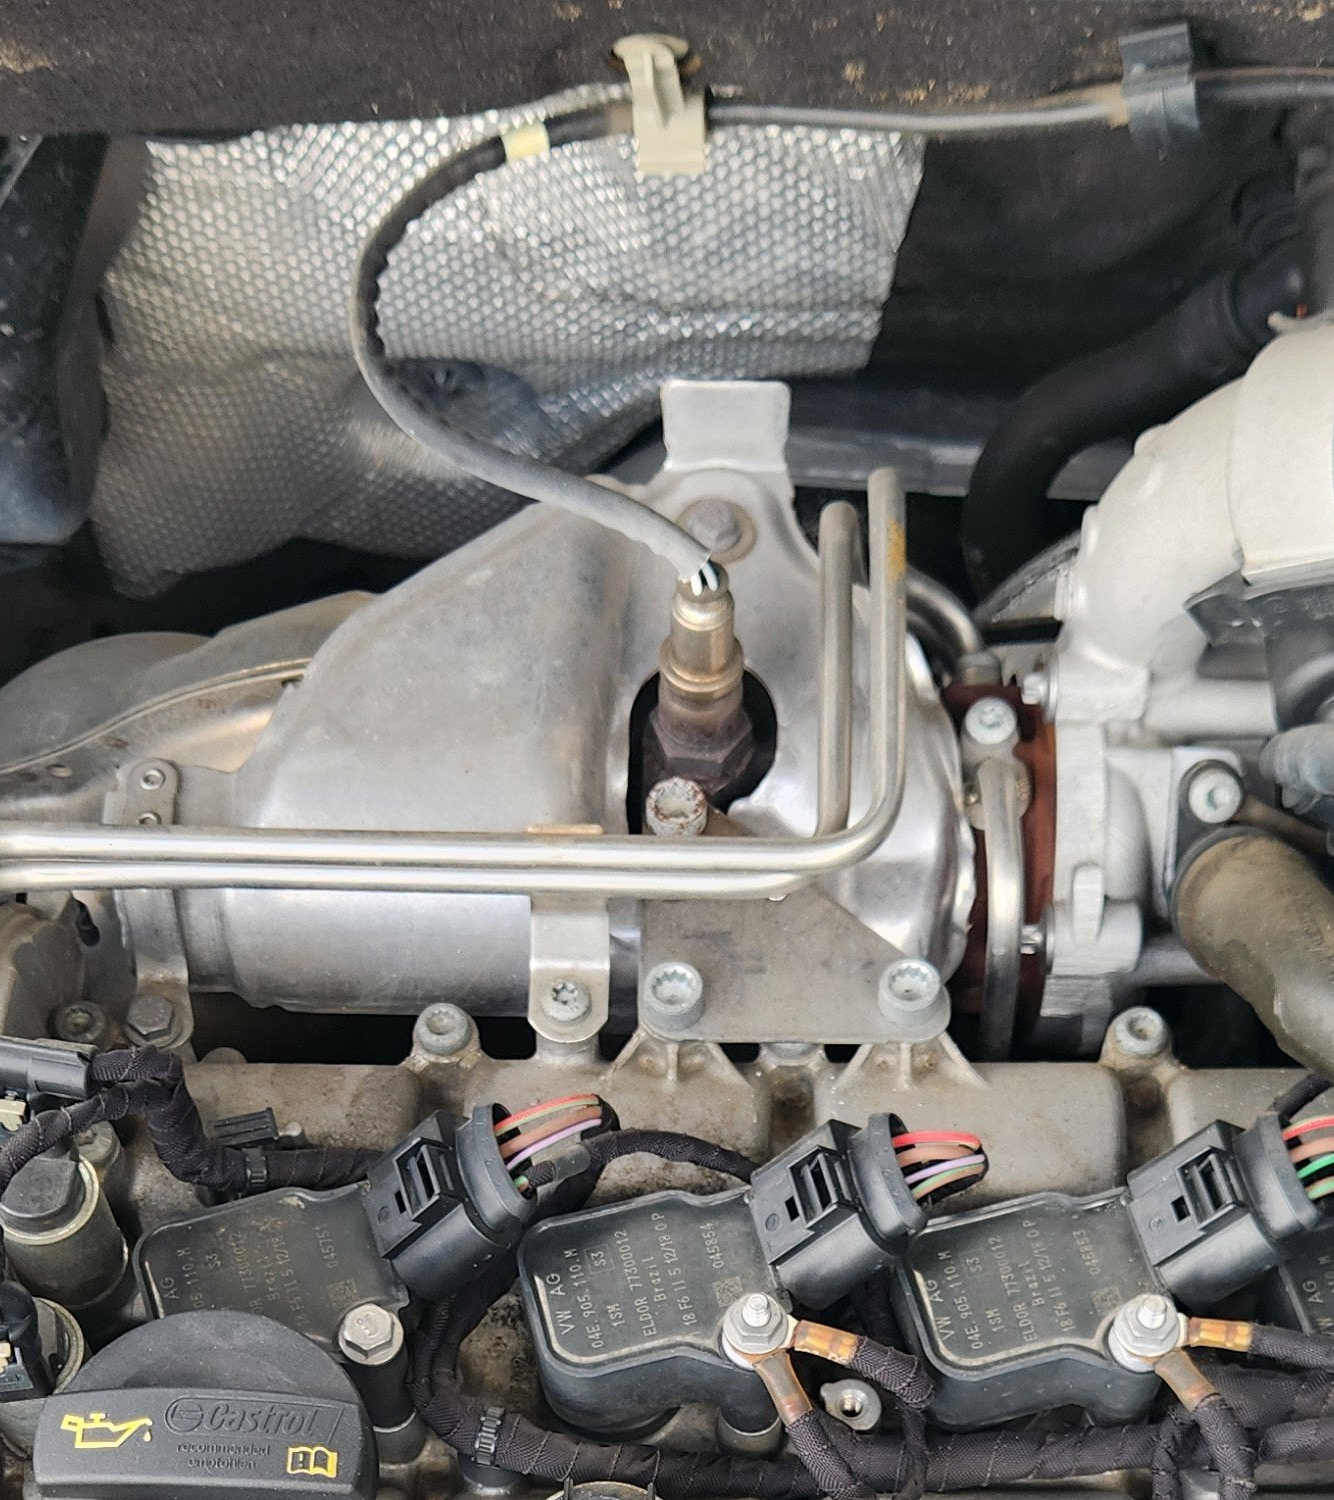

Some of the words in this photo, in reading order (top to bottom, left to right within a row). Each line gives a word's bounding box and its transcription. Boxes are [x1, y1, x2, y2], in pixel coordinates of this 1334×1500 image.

[204, 1252, 222, 1270] S3
[591, 1250, 607, 1268] S3
[614, 1227, 643, 1291] 77300012
[658, 1233, 679, 1264] 12/18
[667, 1266, 681, 1276] 5
[965, 1254, 982, 1273] S3
[988, 1233, 1019, 1298] 77300012
[161, 1276, 179, 1301] AG
[545, 1270, 565, 1298] AG
[642, 1254, 667, 1302] Brazil
[923, 1277, 944, 1305] AG
[1017, 1259, 1044, 1307] Brazil
[1043, 1272, 1055, 1283] 5
[563, 1247, 605, 1348] 04E.905.110.M
[677, 1294, 693, 1310] F6
[1301, 1278, 1324, 1307] AG
[555, 1307, 577, 1334] VW
[606, 1301, 626, 1327] 1SM
[634, 1295, 658, 1336] ELDOR
[682, 1311, 698, 1326] 18
[934, 1313, 956, 1340] VW
[986, 1306, 1005, 1332] 1SM
[1013, 1301, 1037, 1342] ELDOR
[204, 1400, 319, 1437] Castrol
[176, 1439, 270, 1457] recommended
[187, 1454, 256, 1472] empfohlen
